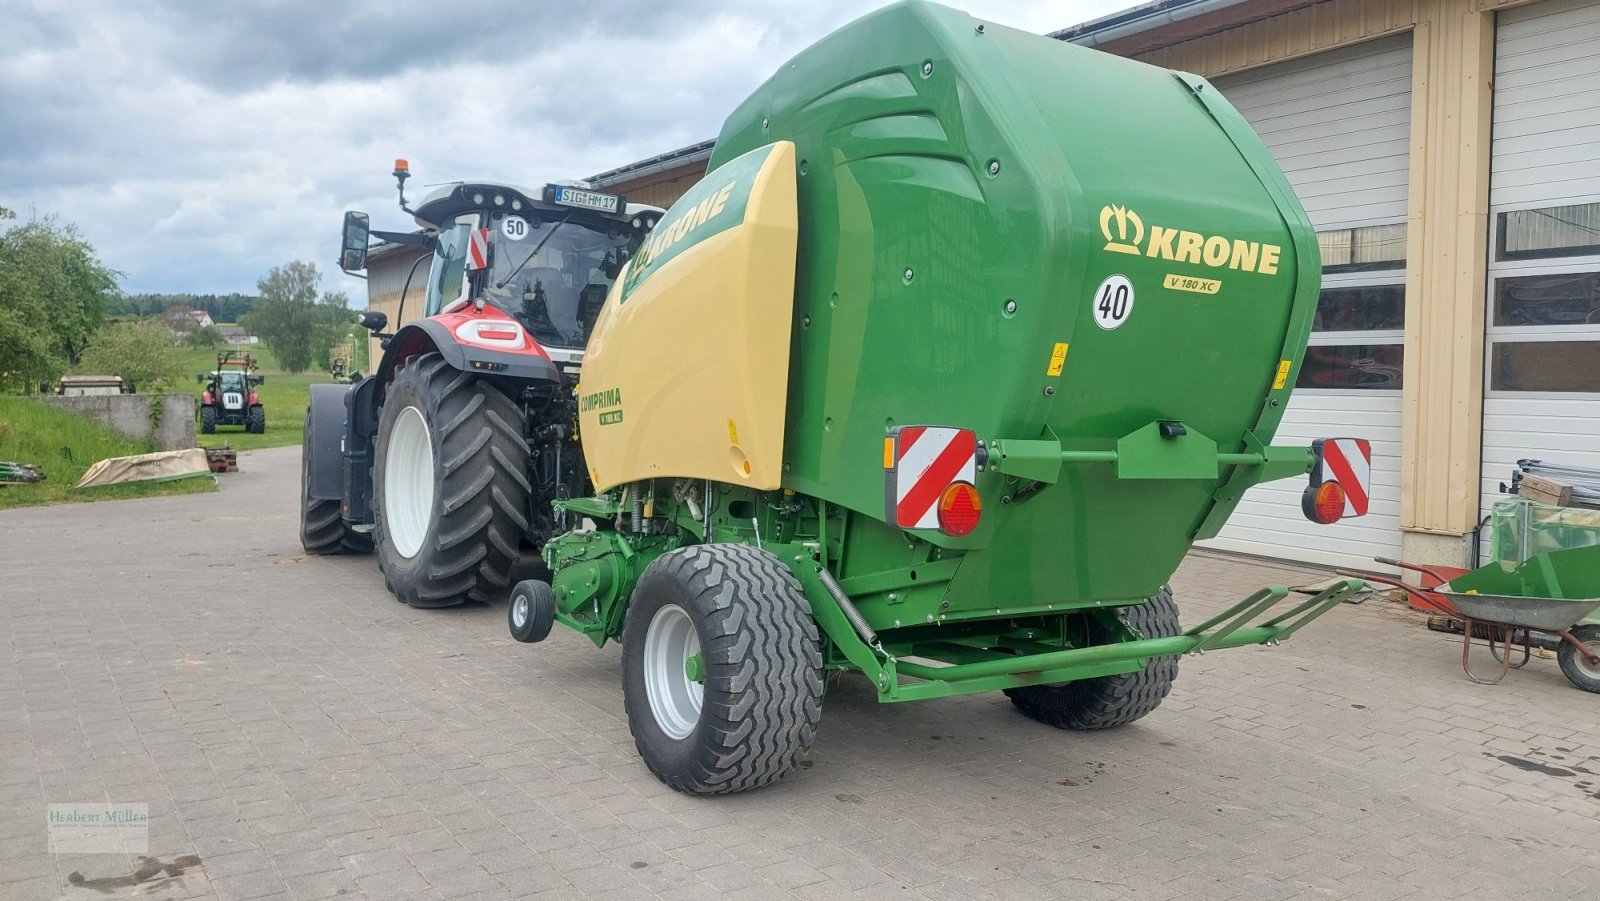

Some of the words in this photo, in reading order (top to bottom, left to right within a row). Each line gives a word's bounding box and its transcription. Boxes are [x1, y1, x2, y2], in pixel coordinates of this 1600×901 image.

[563, 188, 582, 203] SIG
[588, 195, 602, 206] HM
[603, 197, 616, 208] 17
[506, 220, 525, 236] 50
[647, 180, 737, 263] KRONE
[1146, 225, 1282, 276] KRONE
[1170, 277, 1179, 287] V
[1181, 278, 1199, 290] 180
[1199, 281, 1216, 292] XC
[1098, 284, 1129, 321] 40
[581, 387, 622, 413] COMPRIMA
